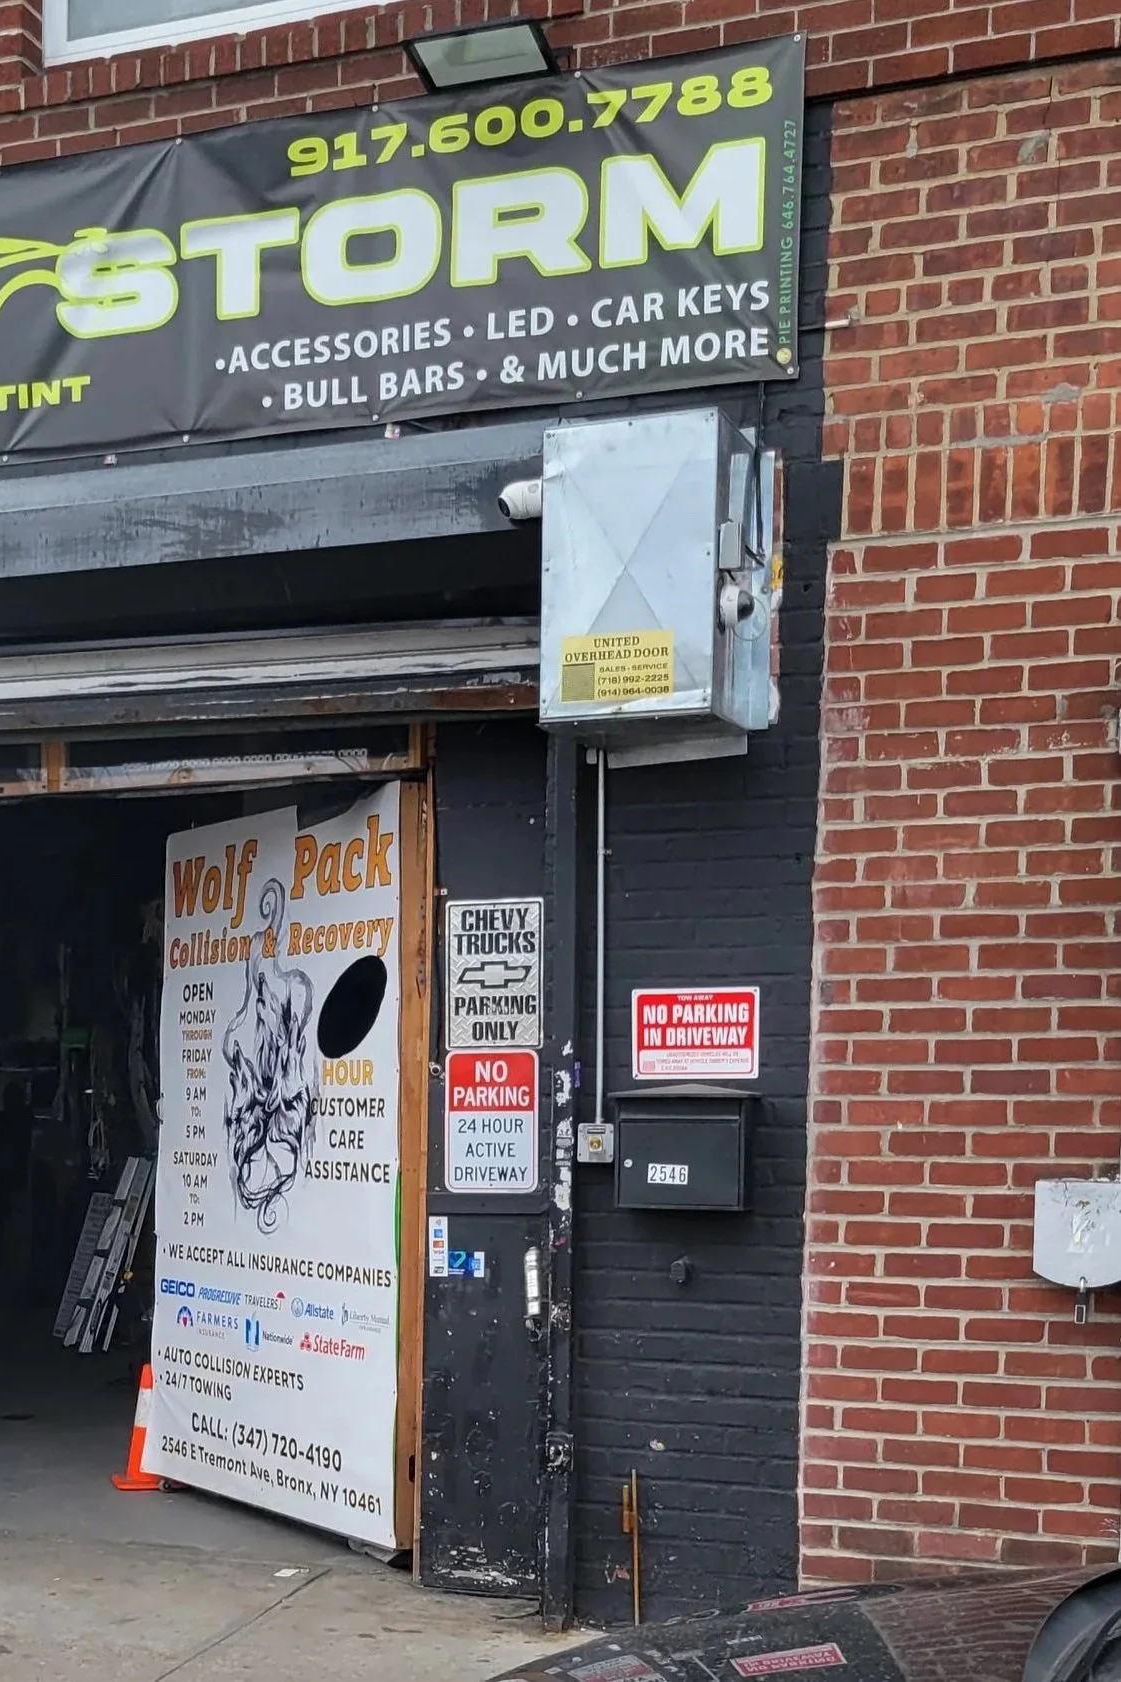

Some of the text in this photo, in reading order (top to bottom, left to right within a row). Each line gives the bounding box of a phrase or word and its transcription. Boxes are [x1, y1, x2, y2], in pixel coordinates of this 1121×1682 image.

[287, 66, 773, 177] 917.600.7788
[55, 136, 766, 339] STORM
[778, 120, 796, 345] PIE PRINTING 646.764.4727
[228, 280, 770, 374] ACCESSORIES LED CAR KEYS
[283, 328, 770, 411] BULL BARS & MUCH MORE
[594, 636, 640, 649] UNITED
[565, 647, 669, 663] OVERHEAD DOOR
[599, 663, 668, 673] SALES SERVICE
[173, 814, 394, 929] Wolf Pack
[461, 909, 529, 933] CHEVY
[169, 927, 252, 969] Collision
[287, 917, 394, 957] Recovery
[454, 930, 536, 956] TRUCKS
[183, 981, 214, 1003] OPEN
[454, 994, 537, 1017] PARKING
[643, 1003, 749, 1025] NO PARKING
[179, 1008, 216, 1026] MONDAY
[182, 1028, 213, 1041] THROUGH
[471, 1021, 519, 1041] ONLY
[644, 1026, 747, 1046] IN DRIVEWAY
[182, 1048, 212, 1063] FRIDAY
[186, 1068, 206, 1080] FROM:
[322, 1060, 374, 1086] HOUR
[475, 1060, 508, 1083] NO
[185, 1088, 207, 1101] 9 AM
[453, 1086, 530, 1108] PARKING
[310, 1098, 385, 1118] CUSTOMER
[185, 1126, 206, 1139] 5 PM
[458, 1118, 523, 1134] 24 HOUR
[329, 1130, 364, 1150] CARE
[465, 1142, 516, 1158] ACTIVE
[173, 1151, 218, 1168] SATURDAY
[182, 1175, 208, 1189] 10 AM
[305, 1160, 390, 1184] ASSISTANCE
[454, 1167, 528, 1182] DRIVEWAY
[649, 1165, 687, 1183] 2546
[184, 1212, 204, 1227] 2 PM
[169, 1243, 392, 1288] WE ACCEPT ALL INSURANCE COMPANIES
[161, 1279, 195, 1297] GEICO
[245, 1294, 279, 1310] TRAVELERS
[305, 1303, 334, 1320] Allstate
[197, 1311, 239, 1330] FARMERS
[263, 1331, 292, 1345] Nationwide
[164, 1347, 304, 1391] AUTO COLLISION EXPERTS
[165, 1370, 232, 1401] 24/7 TOWING
[192, 1412, 342, 1473] CALL: (347) 720-4190
[162, 1435, 382, 1516] 2546 E Tremont Ave, Bronx, NY 10461
